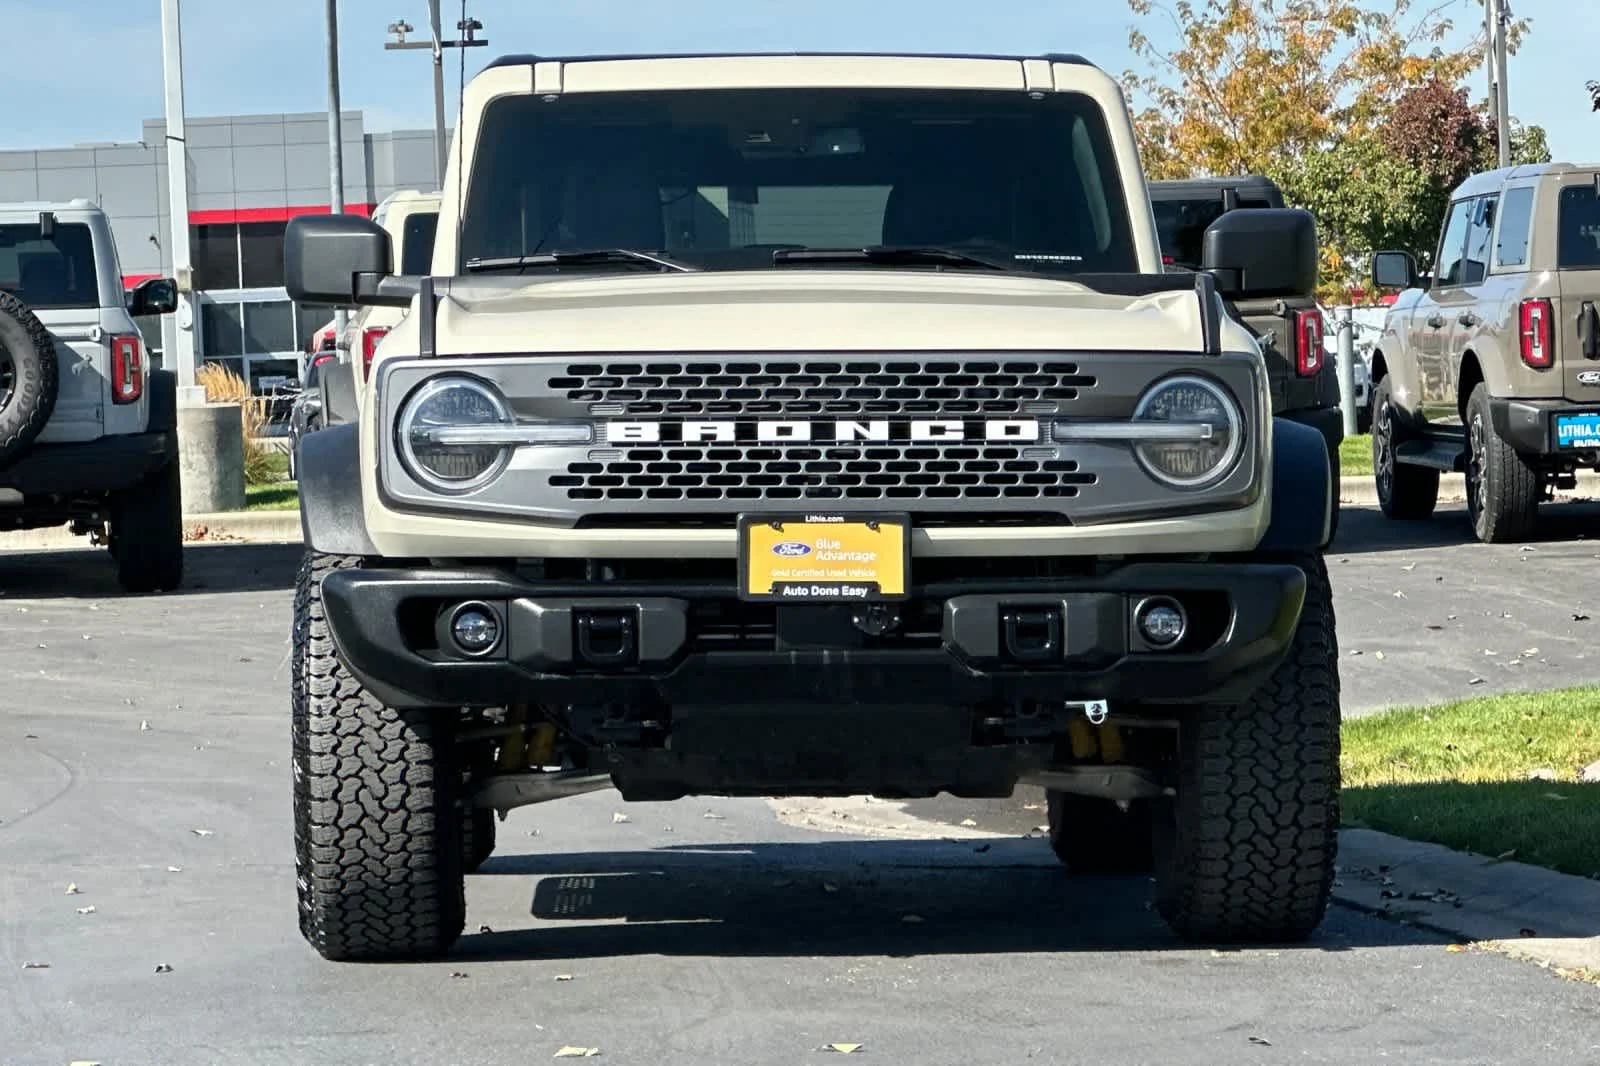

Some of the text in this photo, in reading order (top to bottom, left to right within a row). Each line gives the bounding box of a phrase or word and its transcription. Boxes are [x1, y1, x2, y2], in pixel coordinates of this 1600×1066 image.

[606, 421, 1038, 441] BRONCO
[804, 514, 845, 523] Lithia.com
[777, 542, 808, 556] Ford
[815, 538, 841, 550] Blue
[815, 551, 877, 563] Advantage
[783, 586, 868, 598] Auto Done Easy
